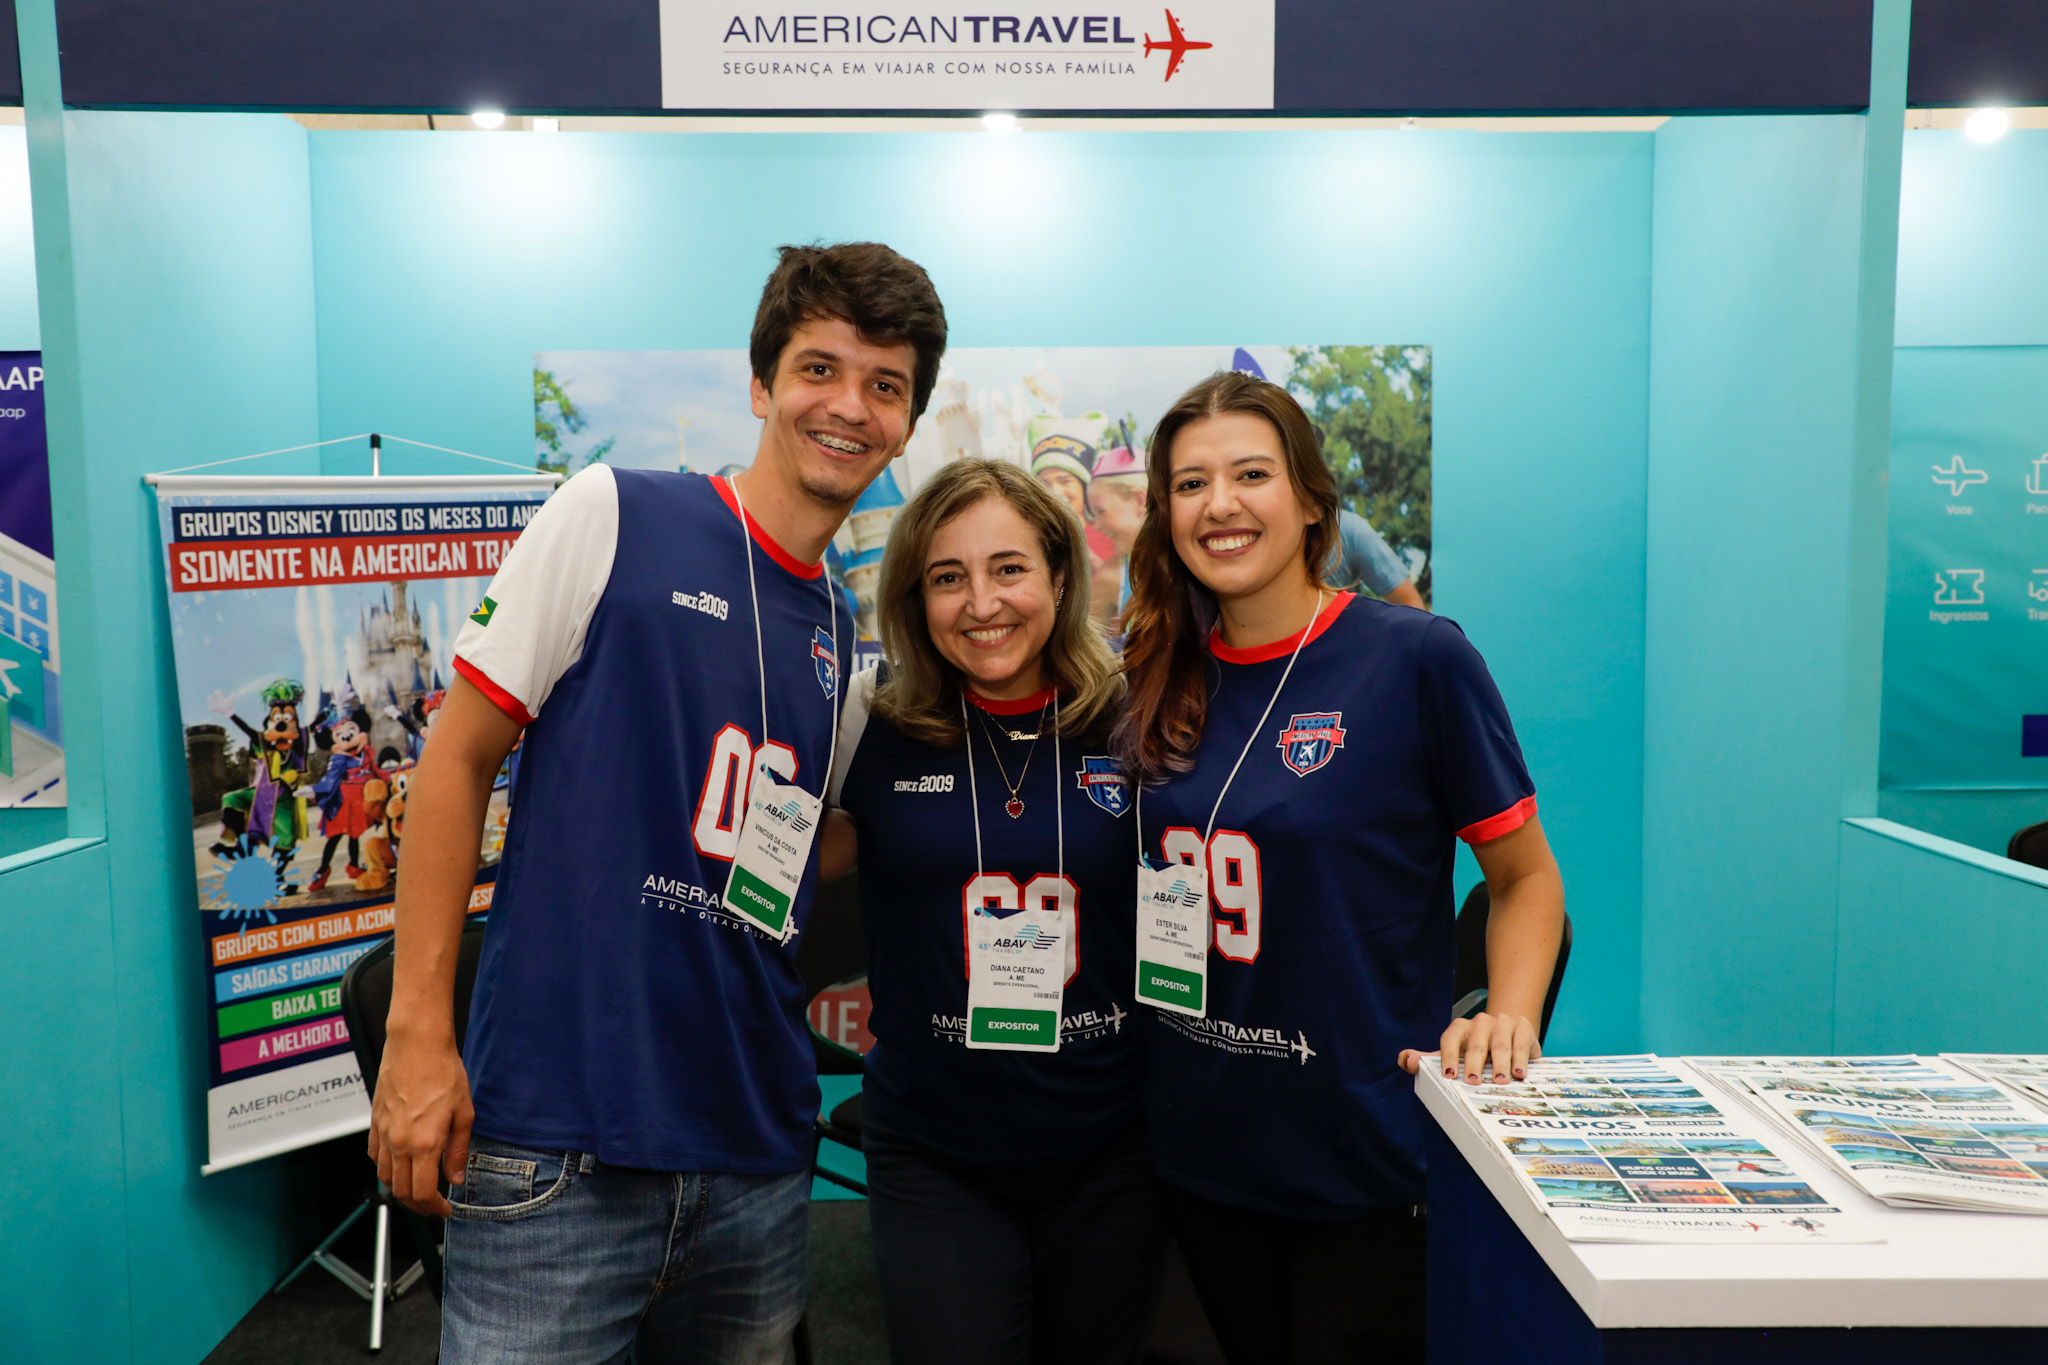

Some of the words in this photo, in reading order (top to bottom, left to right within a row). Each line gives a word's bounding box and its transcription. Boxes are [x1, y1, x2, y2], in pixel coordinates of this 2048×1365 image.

[723, 62, 833, 77] SEGURANÇA
[843, 62, 866, 75] EM
[875, 62, 935, 75] VIAJAR
[945, 62, 986, 75] COM
[996, 62, 1056, 75] NOSSA
[1066, 59, 1136, 75] FAMÍLIA
[180, 511, 262, 537] GRUPOS
[267, 510, 334, 535] DISNEY
[338, 508, 397, 533] TODOS
[401, 508, 425, 531] OS
[429, 506, 482, 530] MESES
[486, 506, 508, 528] DO
[179, 547, 304, 584] SOMENTE
[310, 546, 345, 578] NA
[352, 541, 468, 576] AMERICAN
[672, 591, 698, 610] SINCE
[698, 591, 729, 621] 2009
[1929, 610, 1989, 624] Ingressos
[893, 780, 918, 792] SINCE
[918, 774, 954, 792] 2009
[765, 803, 788, 822] ABAV
[755, 823, 774, 841] VINICIUS
[774, 837, 781, 846] DA
[781, 841, 797, 857] COSTA
[741, 885, 777, 913] EXPOSITOR
[1153, 891, 1179, 904] ABAV
[658, 901, 686, 914] SUA
[1156, 919, 1173, 929] ESTER
[1173, 922, 1188, 932] SILVA
[215, 931, 278, 961] GRUPOS
[282, 923, 315, 947] COM
[318, 916, 352, 938] GUIA
[993, 938, 1028, 949] ABAV
[1171, 931, 1178, 939] ME
[990, 964, 1012, 973] DIANA
[1012, 966, 1045, 975] CAETANO
[232, 964, 288, 994] SAÍDAS
[1151, 976, 1190, 994] EXPOSITOR
[271, 993, 317, 1020] BAIXA
[988, 1020, 1040, 1032] EXPOSITOR
[1084, 1029, 1107, 1040] USA
[258, 1039, 269, 1059] A
[272, 1024, 332, 1056] MELHOR
[1257, 1048, 1290, 1059] FAMÍLIA
[1785, 1093, 1925, 1113] GRUPOS
[1498, 1118, 1637, 1130] GRUPOS
